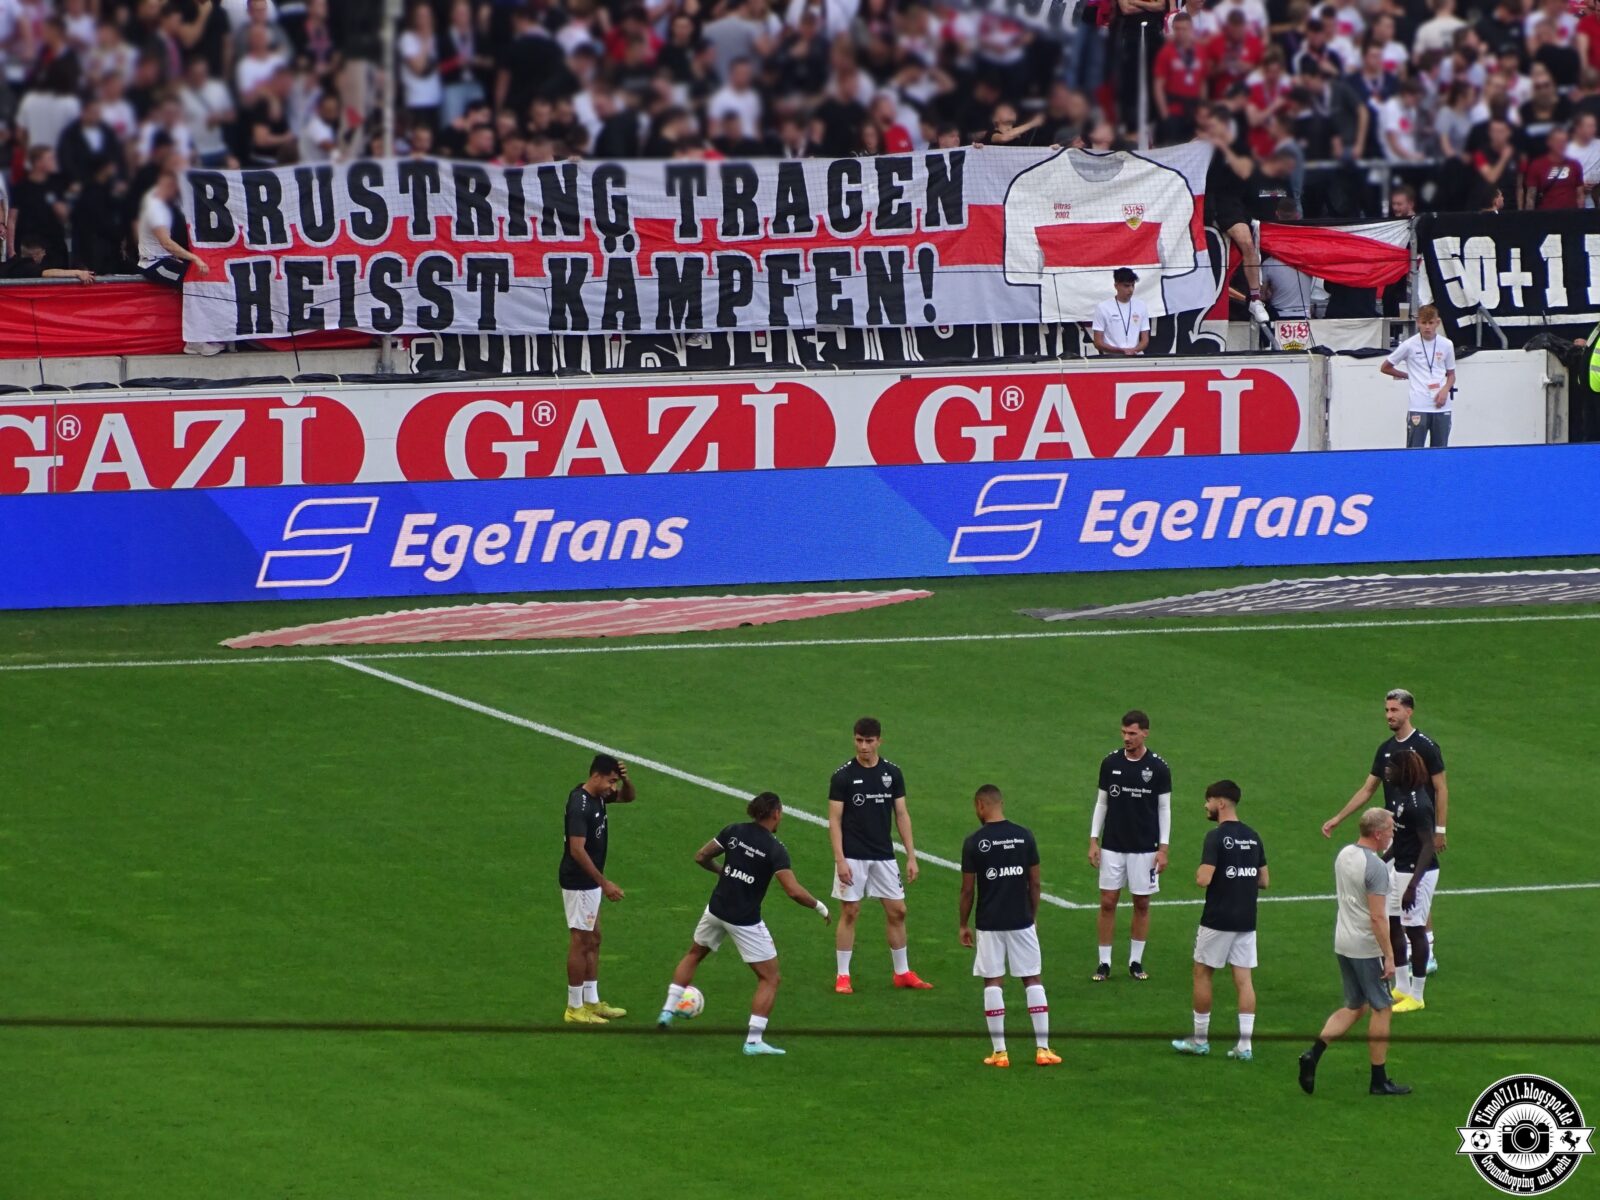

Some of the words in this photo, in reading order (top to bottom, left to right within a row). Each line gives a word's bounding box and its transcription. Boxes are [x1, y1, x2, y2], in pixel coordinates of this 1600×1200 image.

[187, 160, 631, 245] BRUSTRING
[666, 150, 967, 238] TRAGEN
[229, 255, 510, 335] HEISST
[547, 236, 935, 331] KÄMPFEN!
[1433, 234, 1568, 309] 50+1
[390, 508, 690, 582] EgeTrans
[1078, 485, 1374, 558] EgeTrans
[730, 868, 755, 884] JAKO
[999, 866, 1024, 877] JAKO
